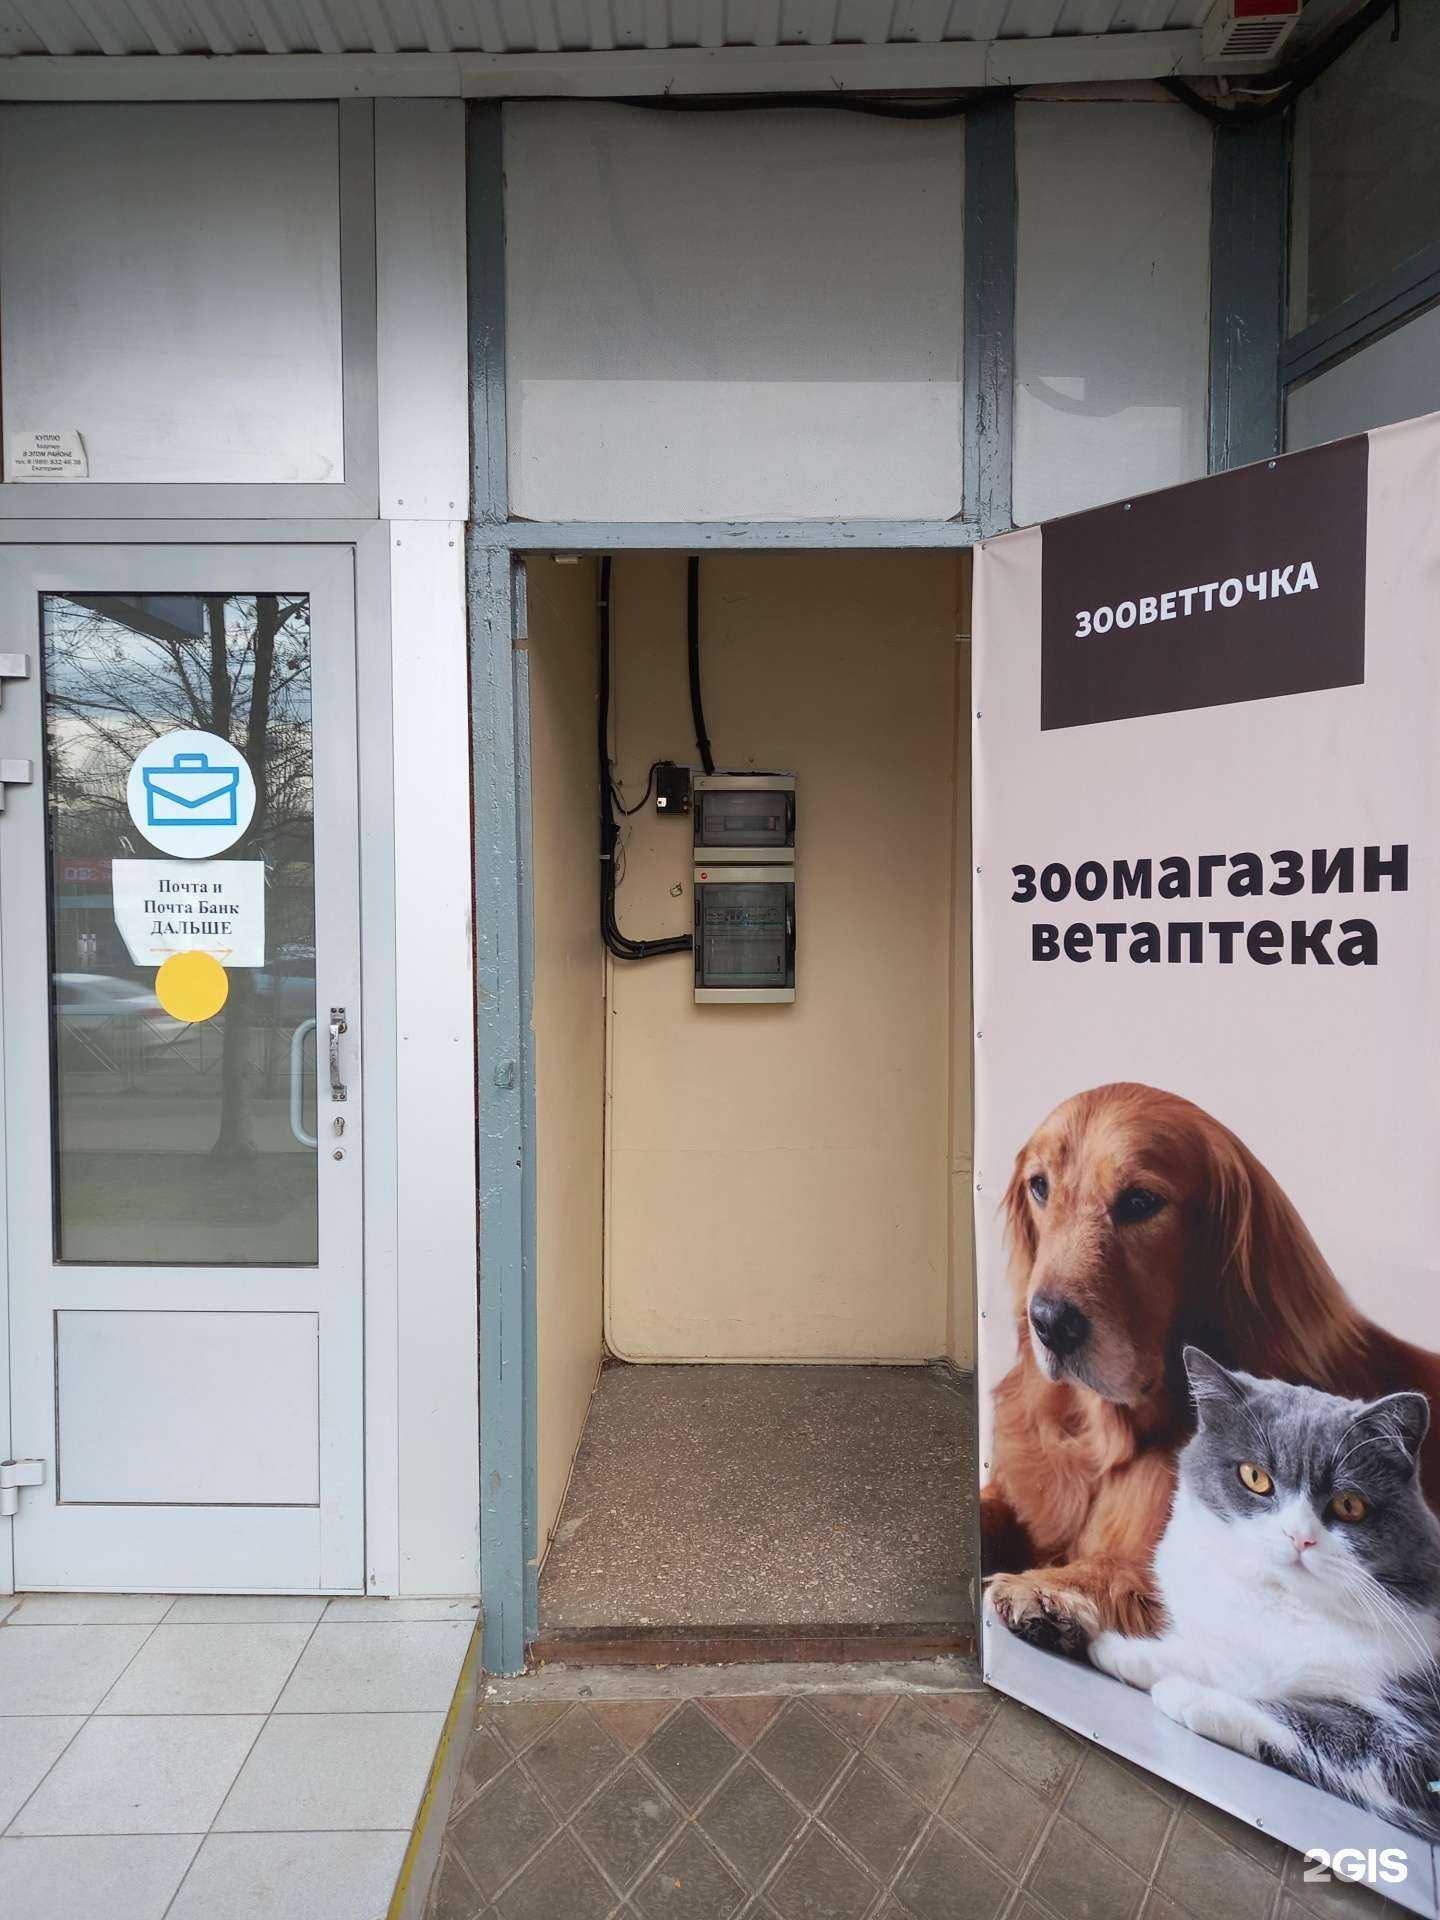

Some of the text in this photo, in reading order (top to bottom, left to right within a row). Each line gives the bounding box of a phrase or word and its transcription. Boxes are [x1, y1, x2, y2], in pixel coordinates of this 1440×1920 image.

[1075, 561, 1319, 638] ЗООВЕТТОЧКА
[159, 880, 223, 894] Почта и
[1011, 844, 1409, 904] зоомагазин
[144, 900, 240, 914] Почта Банк
[151, 921, 232, 936] ДАЛЬШЕ
[1032, 917, 1379, 967] ветаптека
